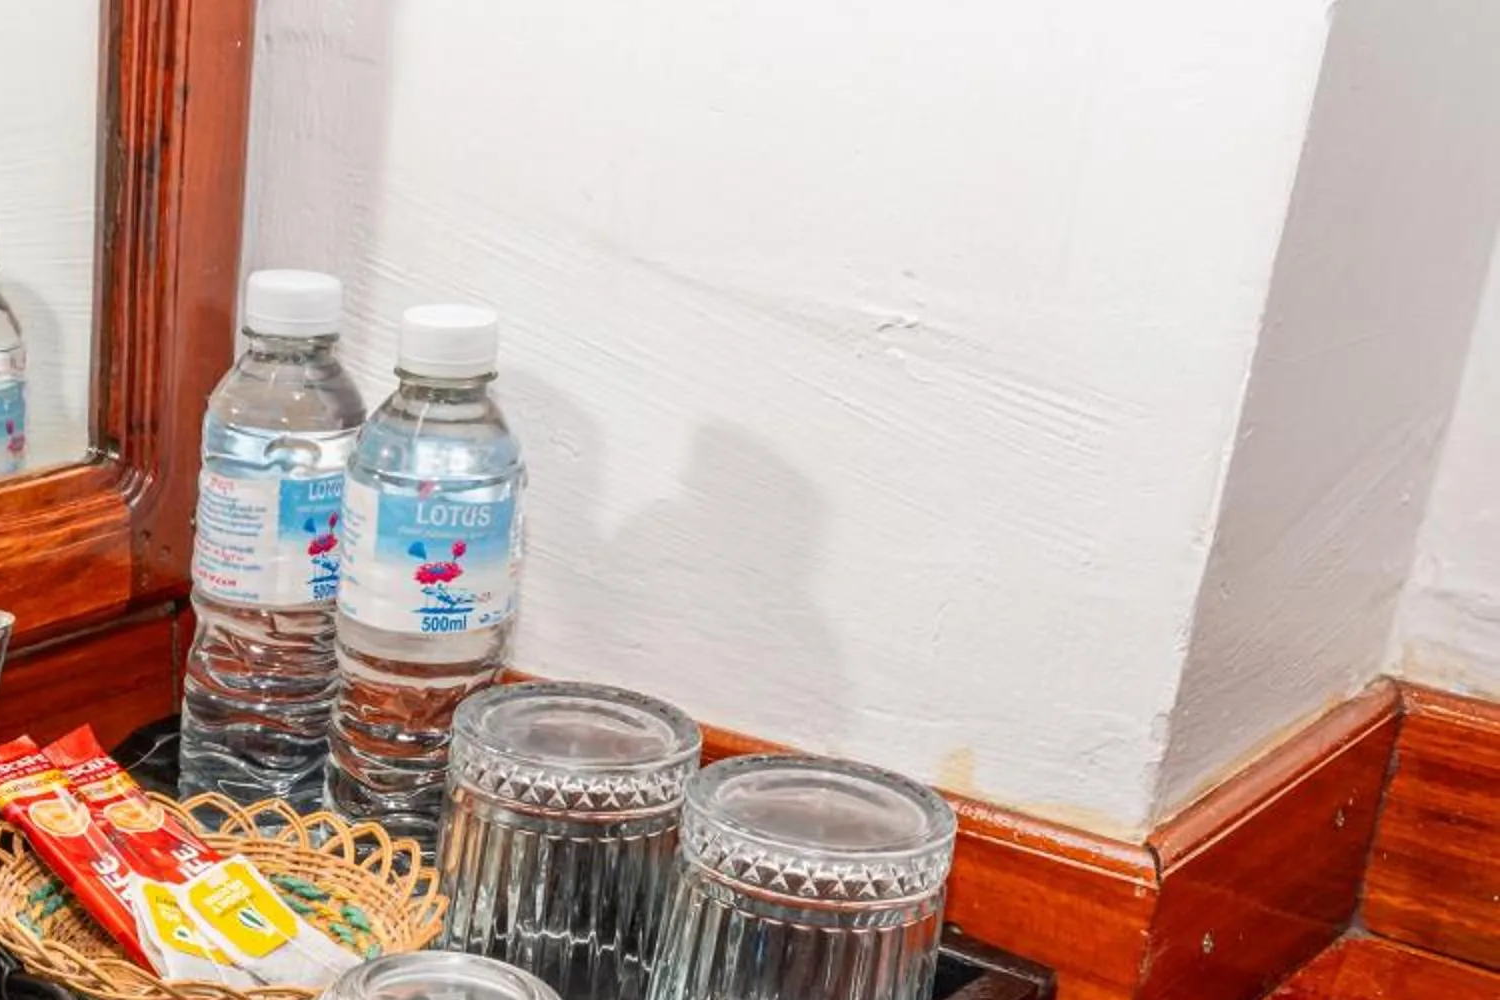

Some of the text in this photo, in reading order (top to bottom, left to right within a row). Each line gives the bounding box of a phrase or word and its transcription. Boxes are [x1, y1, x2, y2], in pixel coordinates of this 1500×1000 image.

[307, 479, 341, 500] LOTU
[416, 502, 491, 527] LOTUS
[420, 614, 467, 632] 500ml
